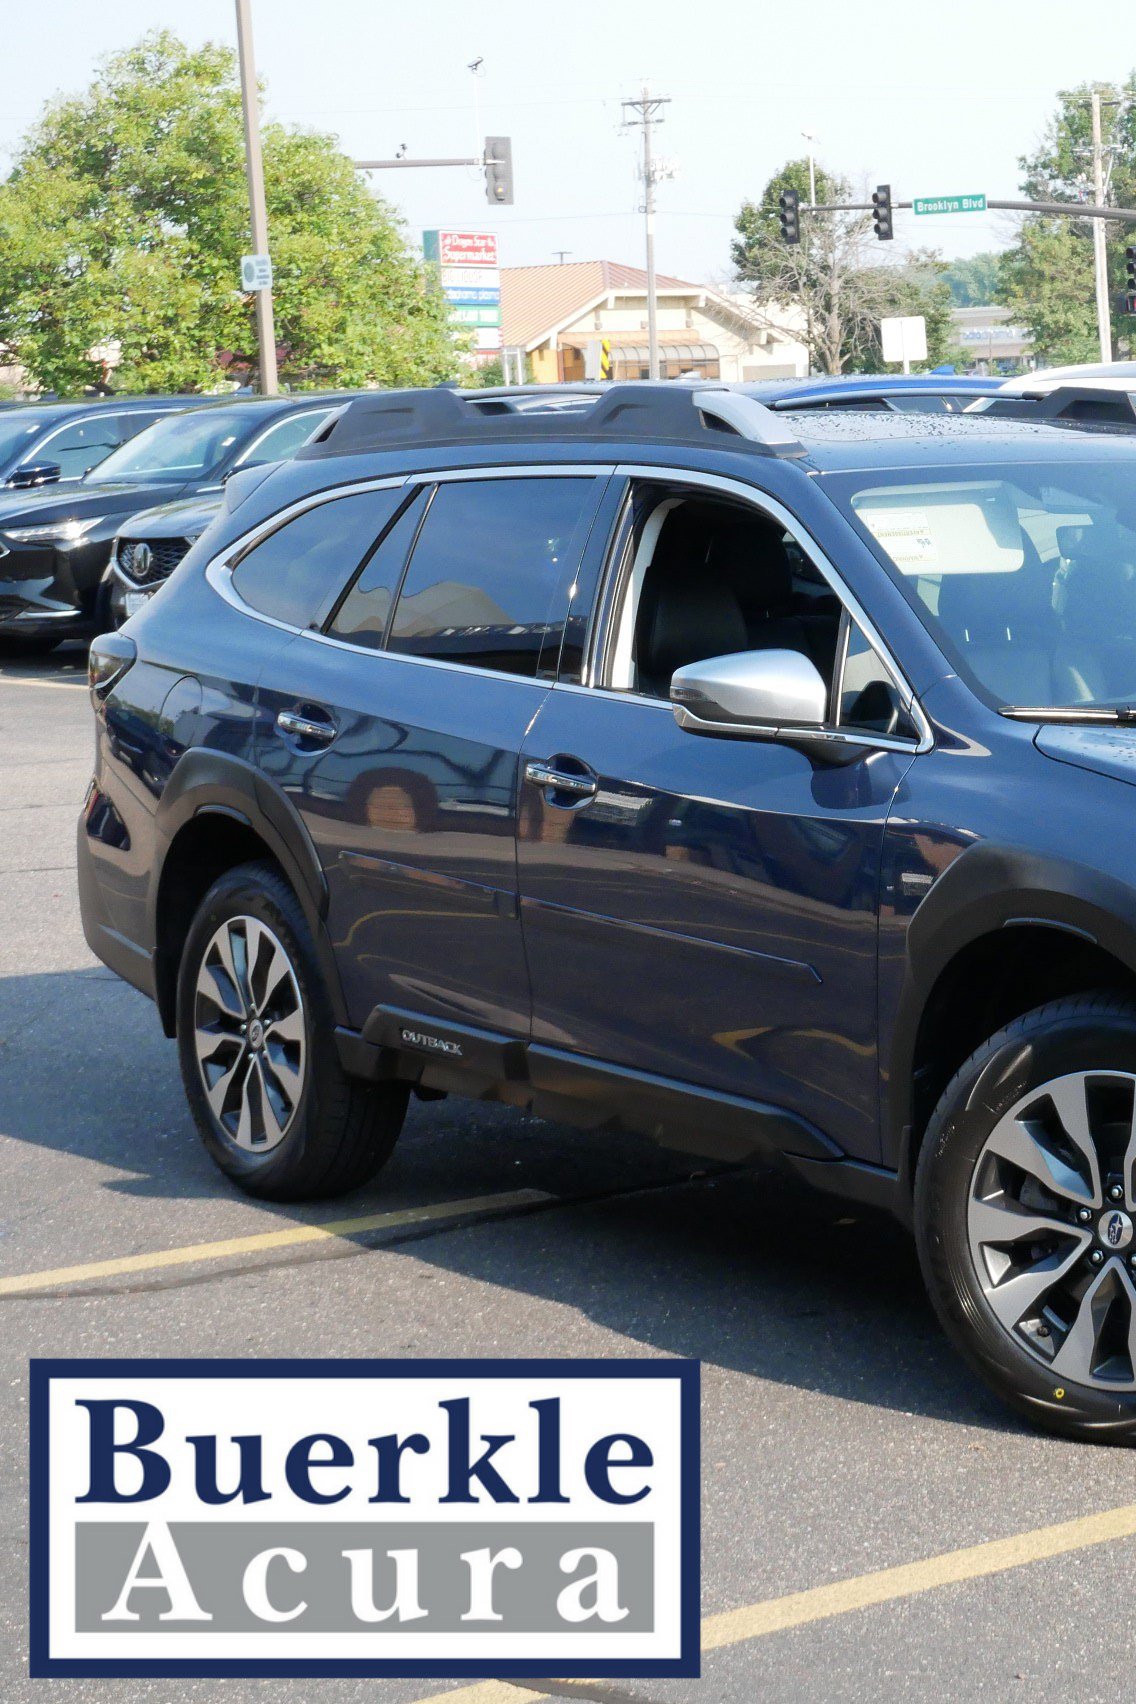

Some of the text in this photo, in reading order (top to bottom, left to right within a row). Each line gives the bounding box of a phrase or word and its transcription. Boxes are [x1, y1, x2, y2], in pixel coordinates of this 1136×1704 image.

[917, 198, 984, 213] Brooklyn Blvd
[444, 246, 496, 262] Supermarket
[402, 1029, 463, 1056] OUTBACK
